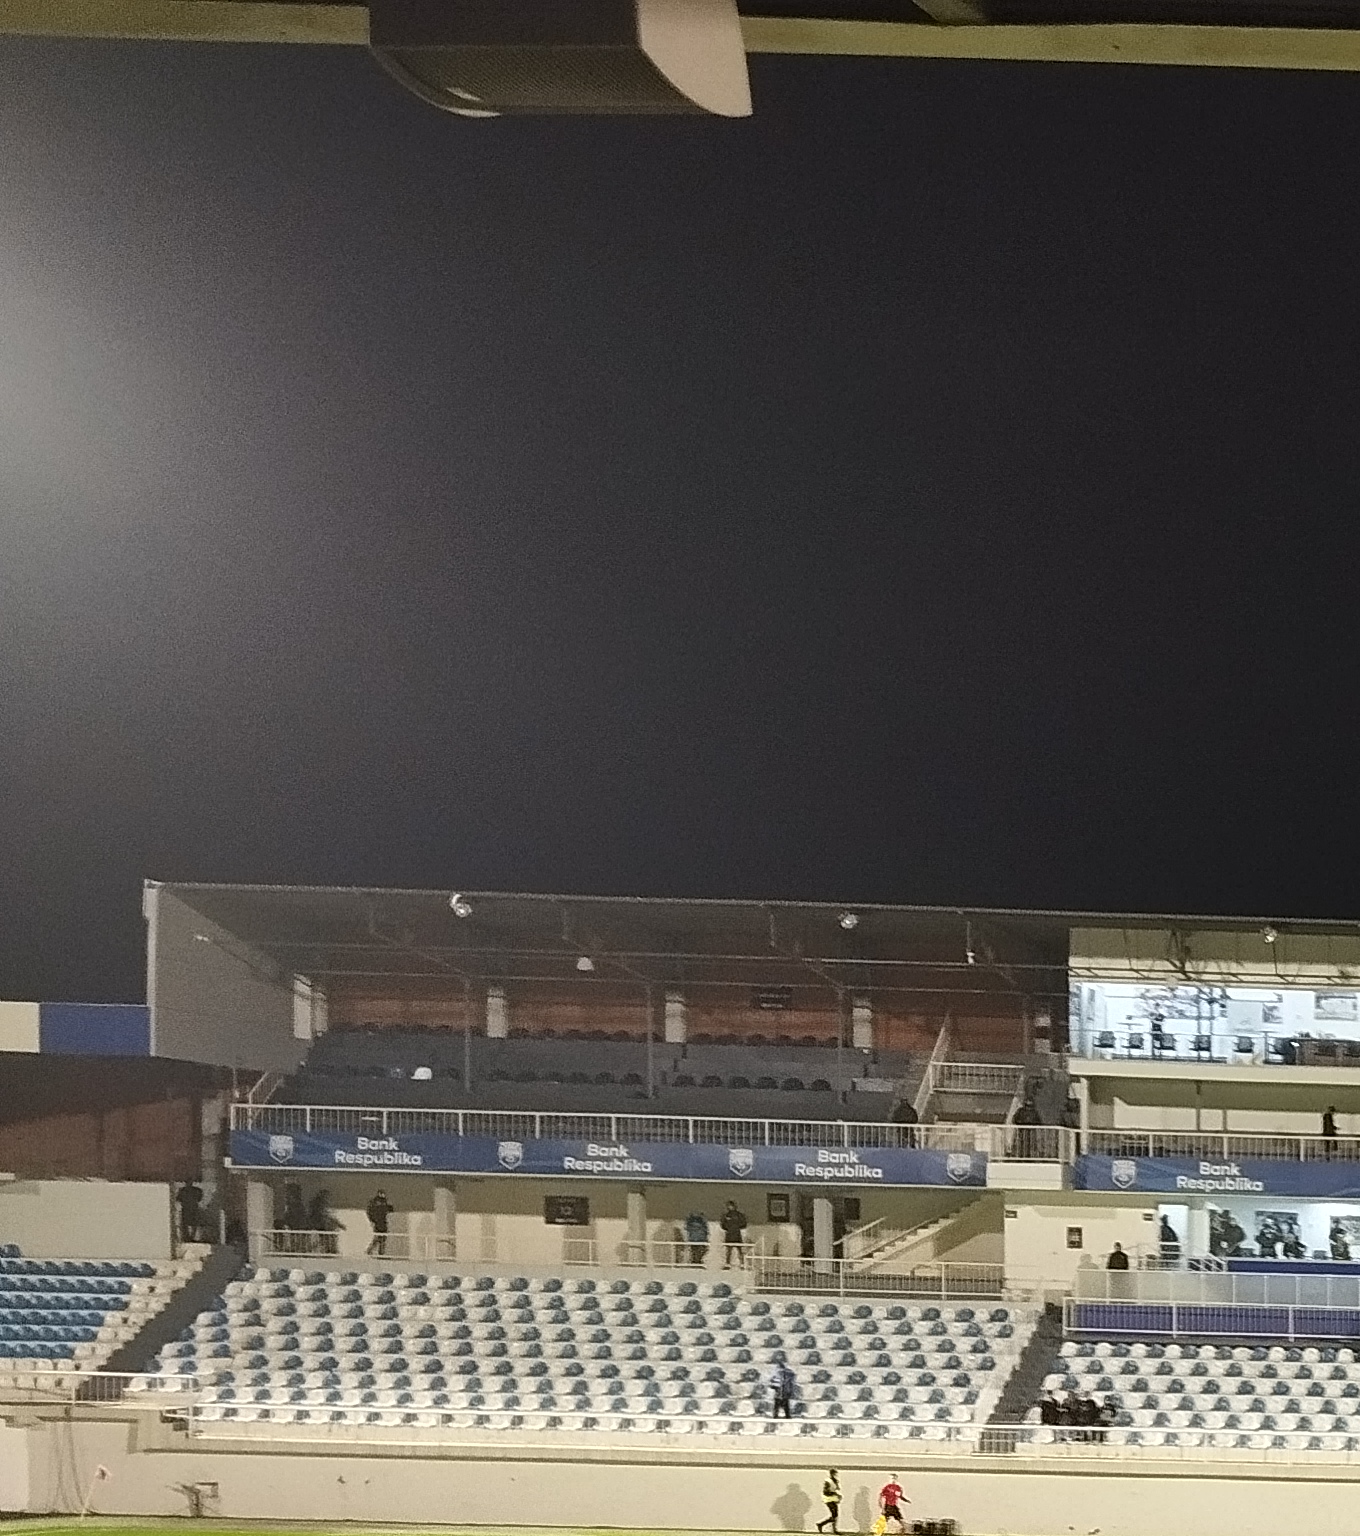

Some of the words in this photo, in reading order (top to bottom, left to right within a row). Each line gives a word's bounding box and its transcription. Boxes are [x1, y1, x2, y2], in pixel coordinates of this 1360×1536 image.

[357, 1137, 399, 1151] Bank
[586, 1143, 629, 1157] Bank
[335, 1150, 422, 1167] Respublika
[817, 1150, 860, 1163] Bank
[564, 1156, 652, 1174] Respublika
[795, 1163, 883, 1180] Respublika
[1199, 1161, 1241, 1177] Bank
[1176, 1175, 1264, 1193] Respublika
